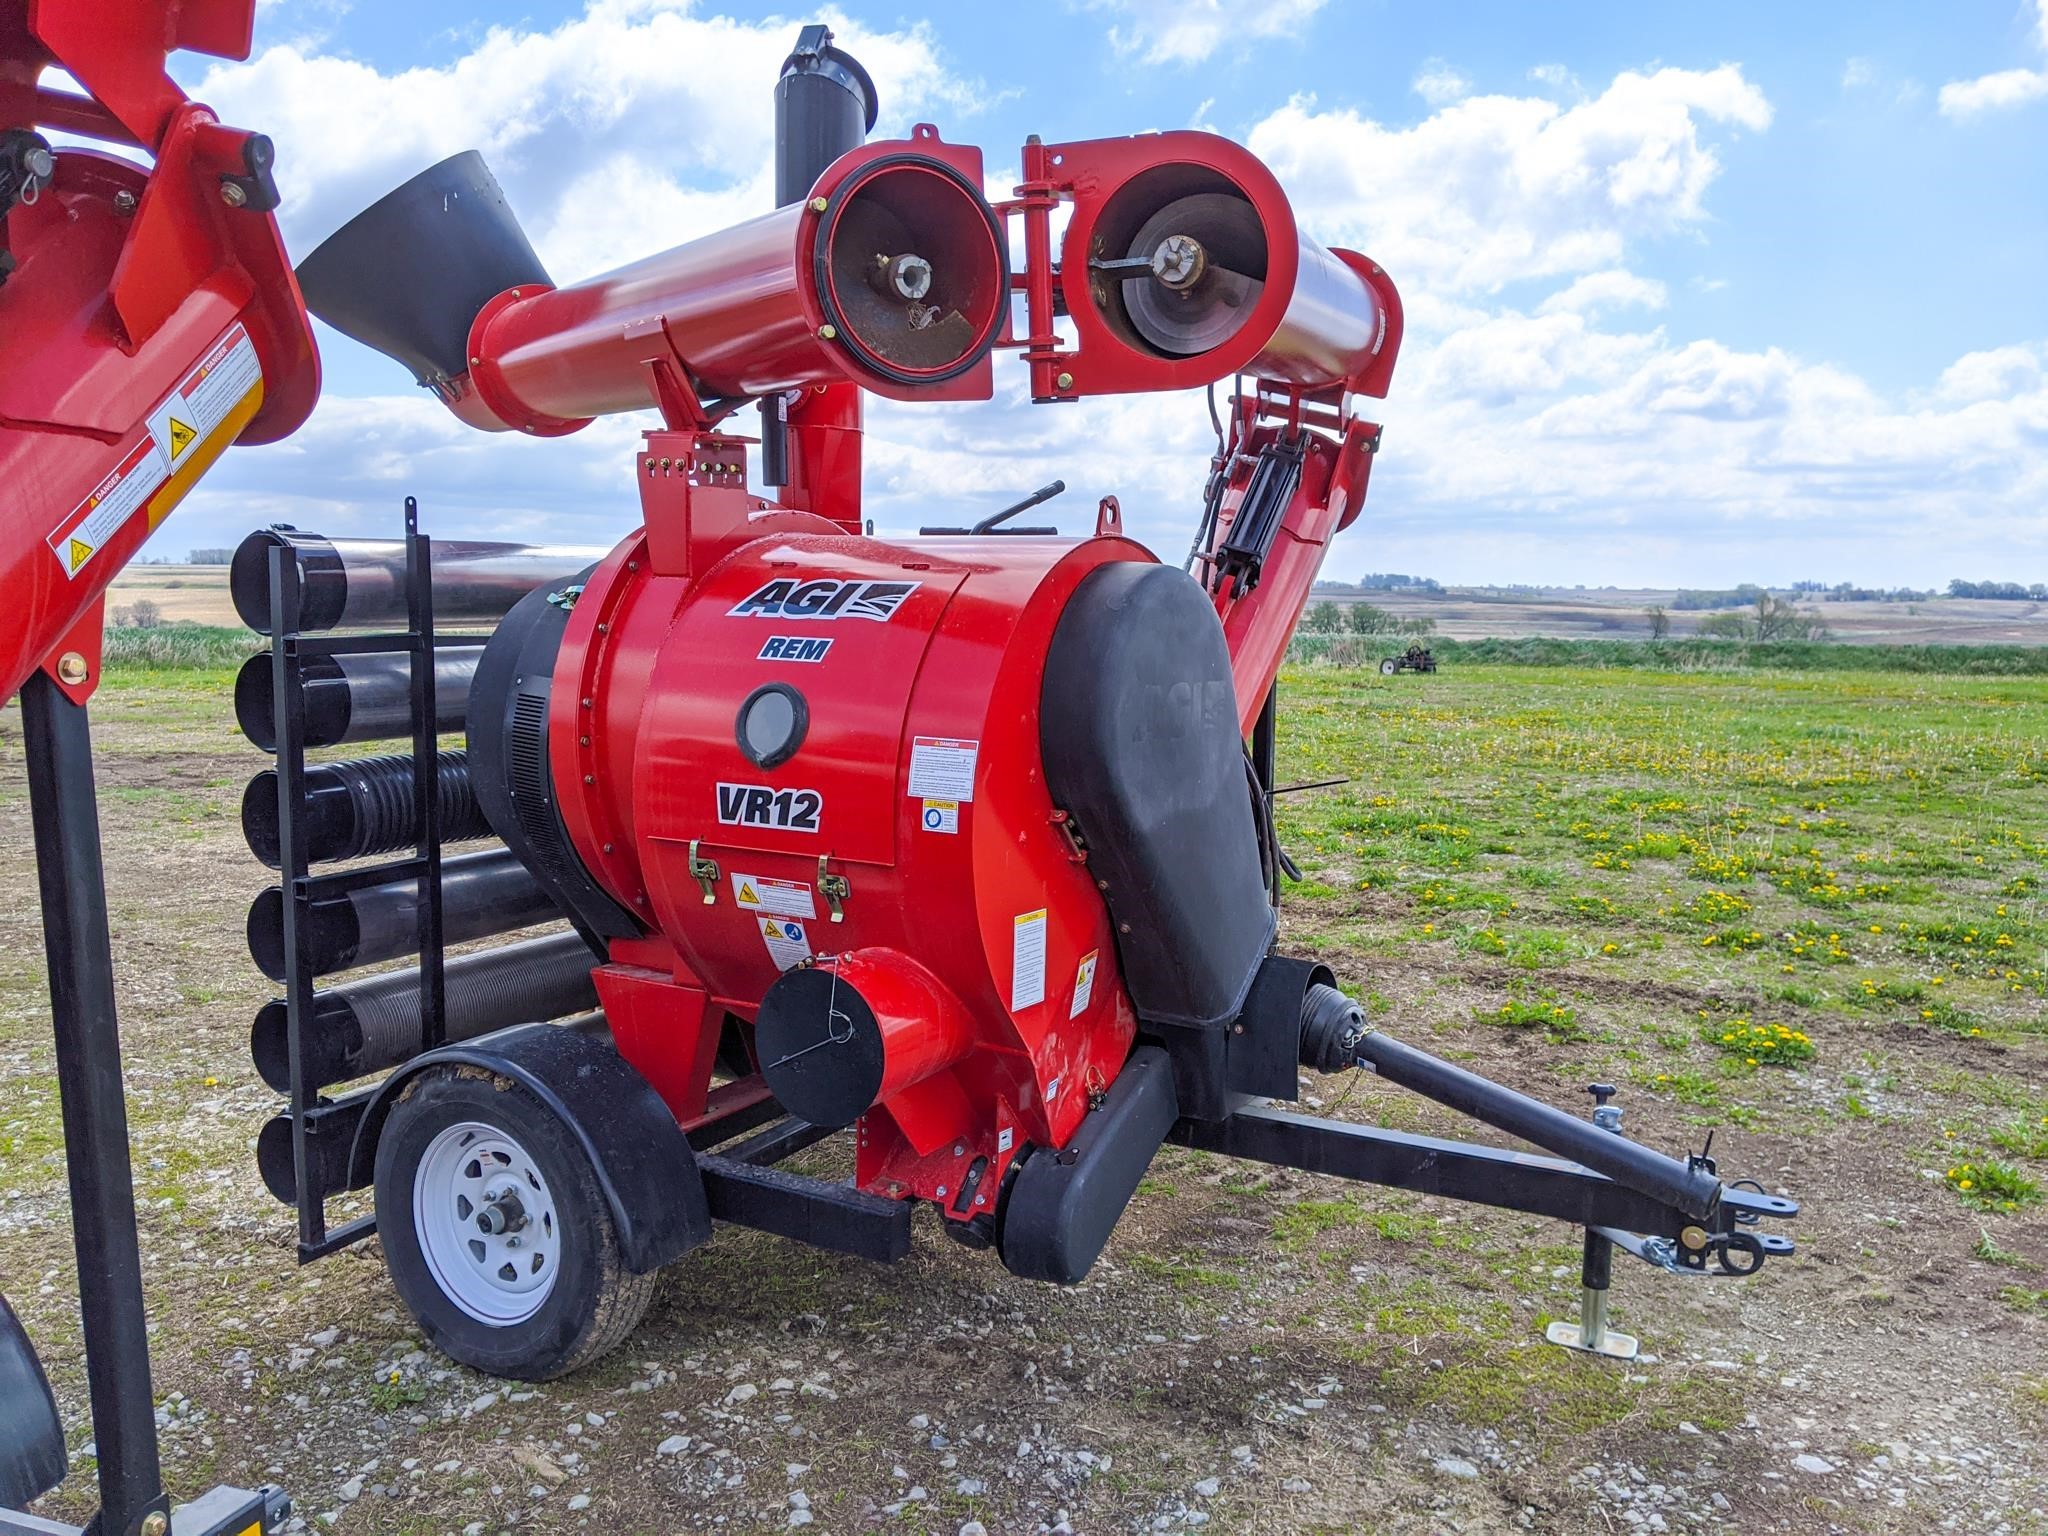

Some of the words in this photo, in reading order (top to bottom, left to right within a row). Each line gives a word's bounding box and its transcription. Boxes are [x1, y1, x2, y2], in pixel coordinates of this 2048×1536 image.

[205, 345, 228, 371] DANGER
[95, 472, 122, 501] DANGER
[731, 579, 864, 617] AGI
[759, 637, 830, 661] REM
[718, 785, 820, 829] VR12
